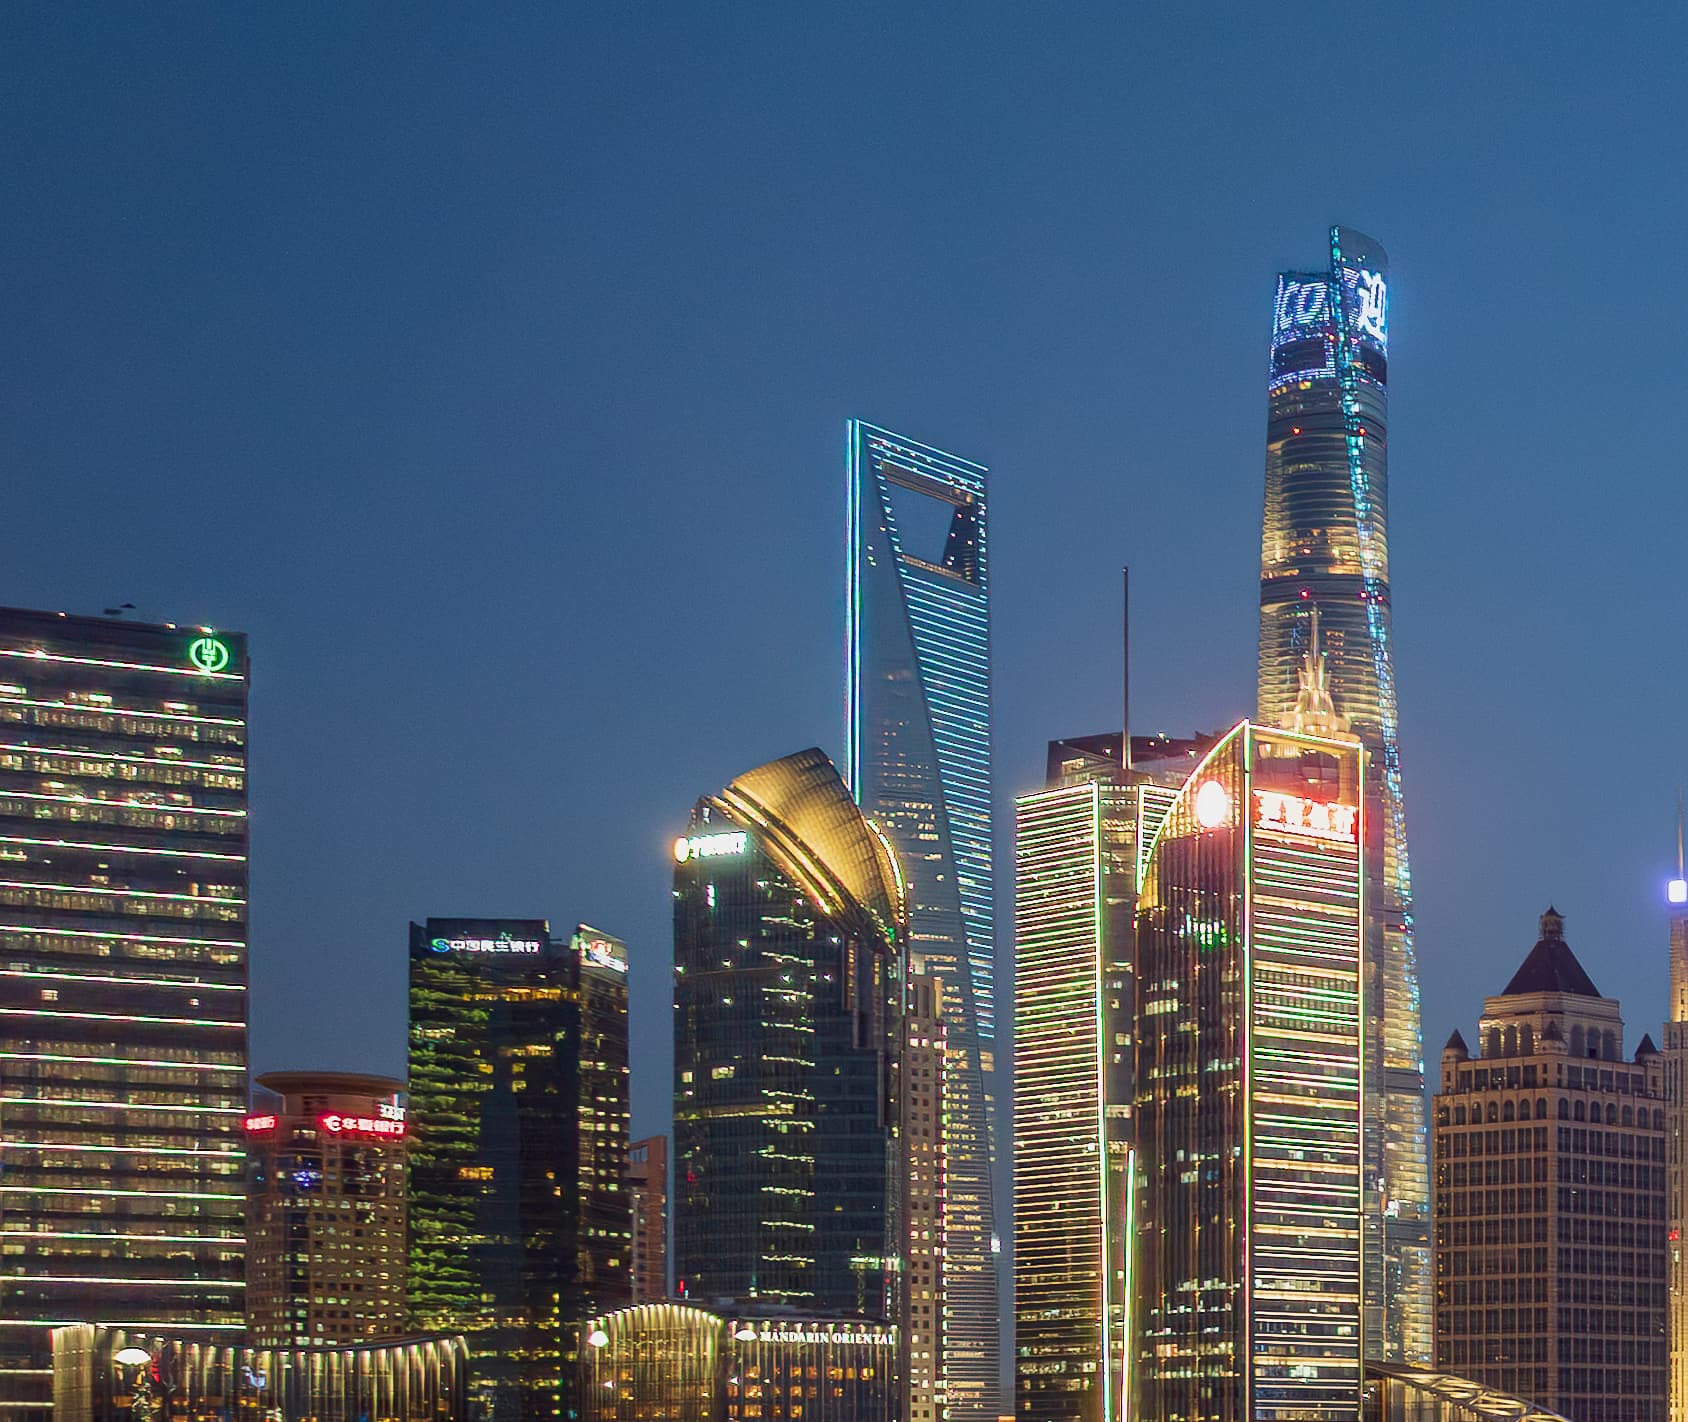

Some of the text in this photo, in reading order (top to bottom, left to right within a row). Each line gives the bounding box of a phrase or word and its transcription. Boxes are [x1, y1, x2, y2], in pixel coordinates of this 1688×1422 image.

[450, 940, 541, 954] 中国民生银行
[759, 1331, 895, 1345] MANDARIN ORIENTAL
